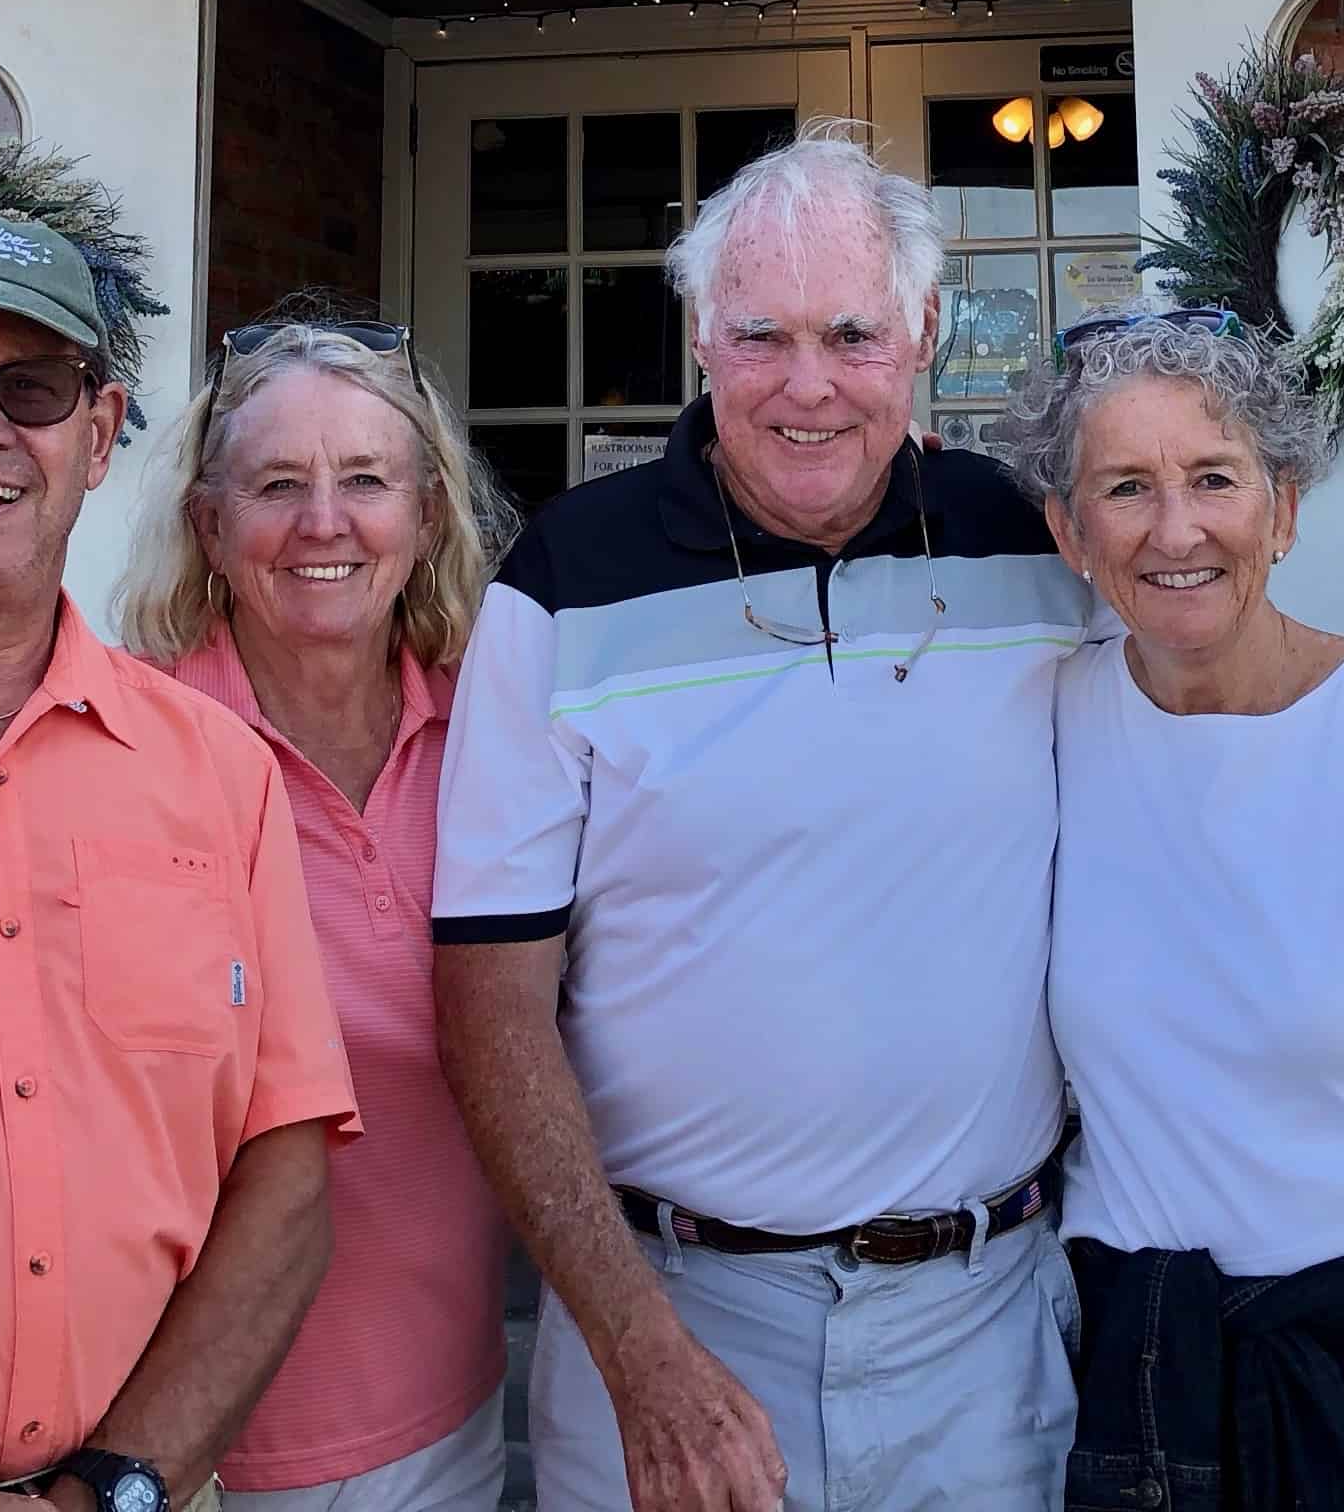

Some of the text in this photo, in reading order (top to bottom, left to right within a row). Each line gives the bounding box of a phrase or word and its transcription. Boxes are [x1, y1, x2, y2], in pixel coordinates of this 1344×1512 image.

[1052, 64, 1109, 77] No Smoking
[591, 443, 652, 454] RESTROOMS
